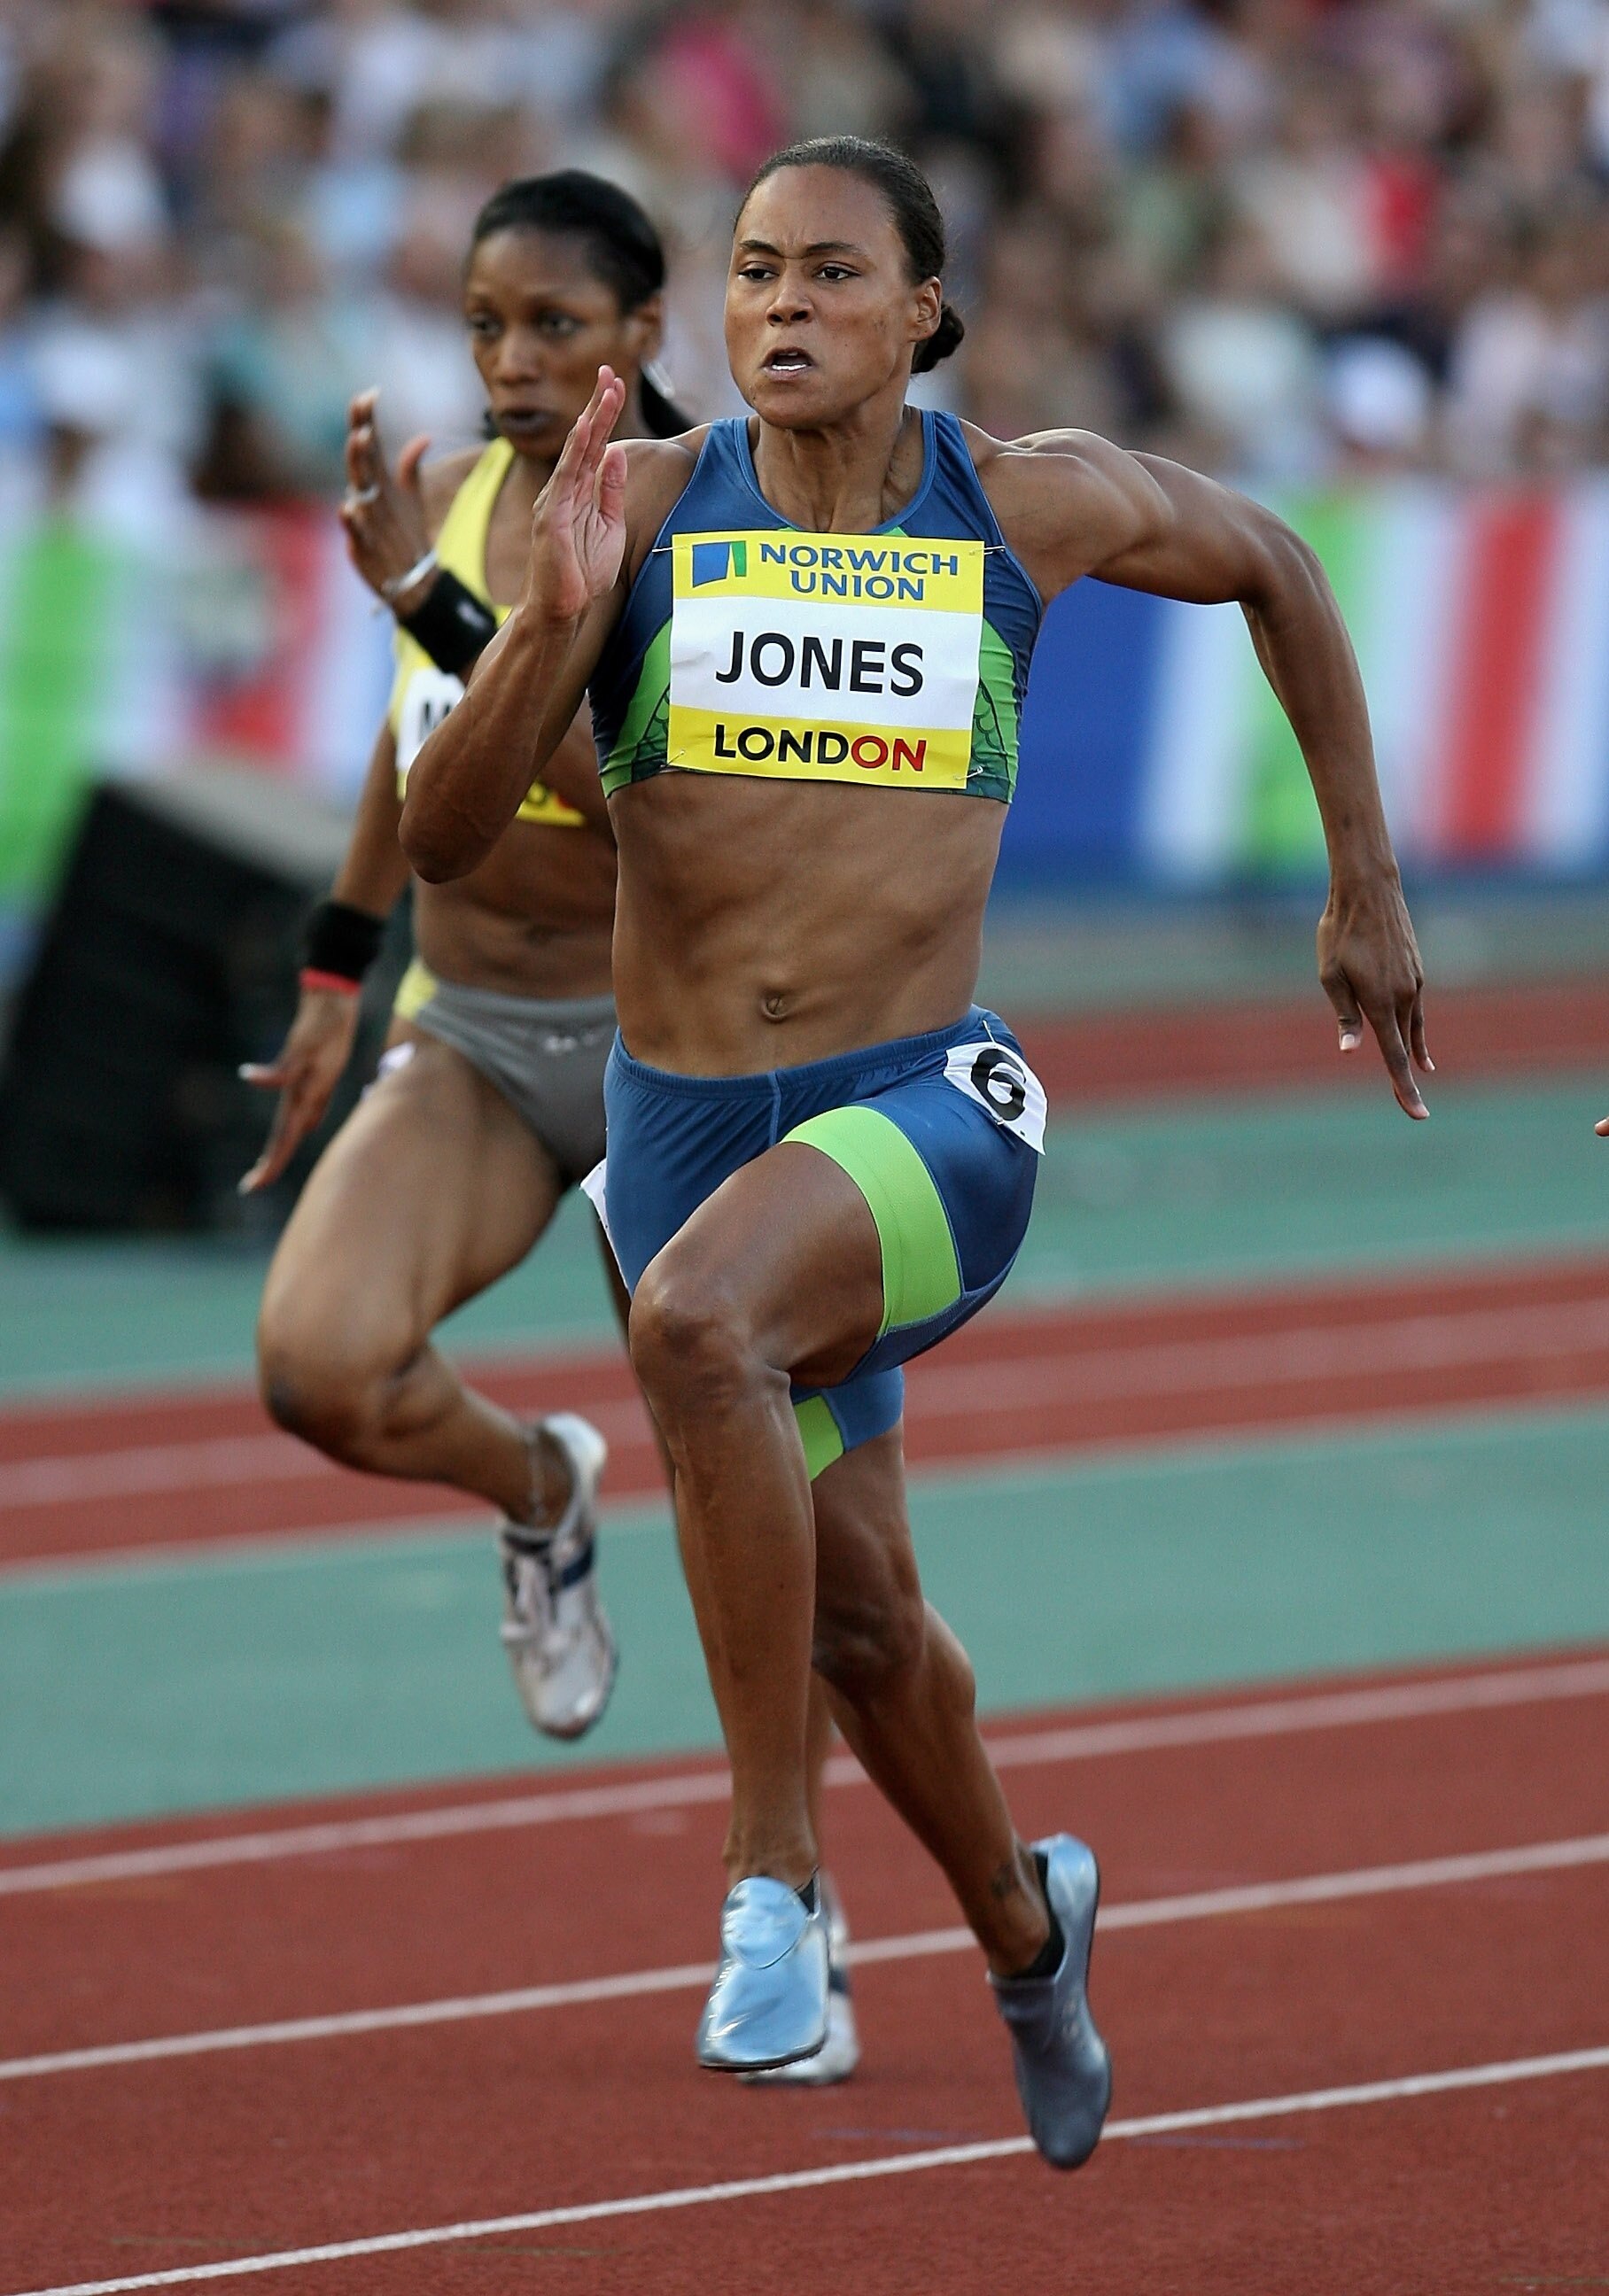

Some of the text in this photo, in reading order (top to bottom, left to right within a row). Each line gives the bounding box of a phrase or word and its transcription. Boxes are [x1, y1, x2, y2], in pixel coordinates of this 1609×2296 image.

[760, 543, 958, 576] NORWICH
[789, 570, 924, 601] UNION
[716, 632, 923, 696] JONES
[714, 724, 927, 772] LONDON
[971, 1049, 1026, 1121] 6
